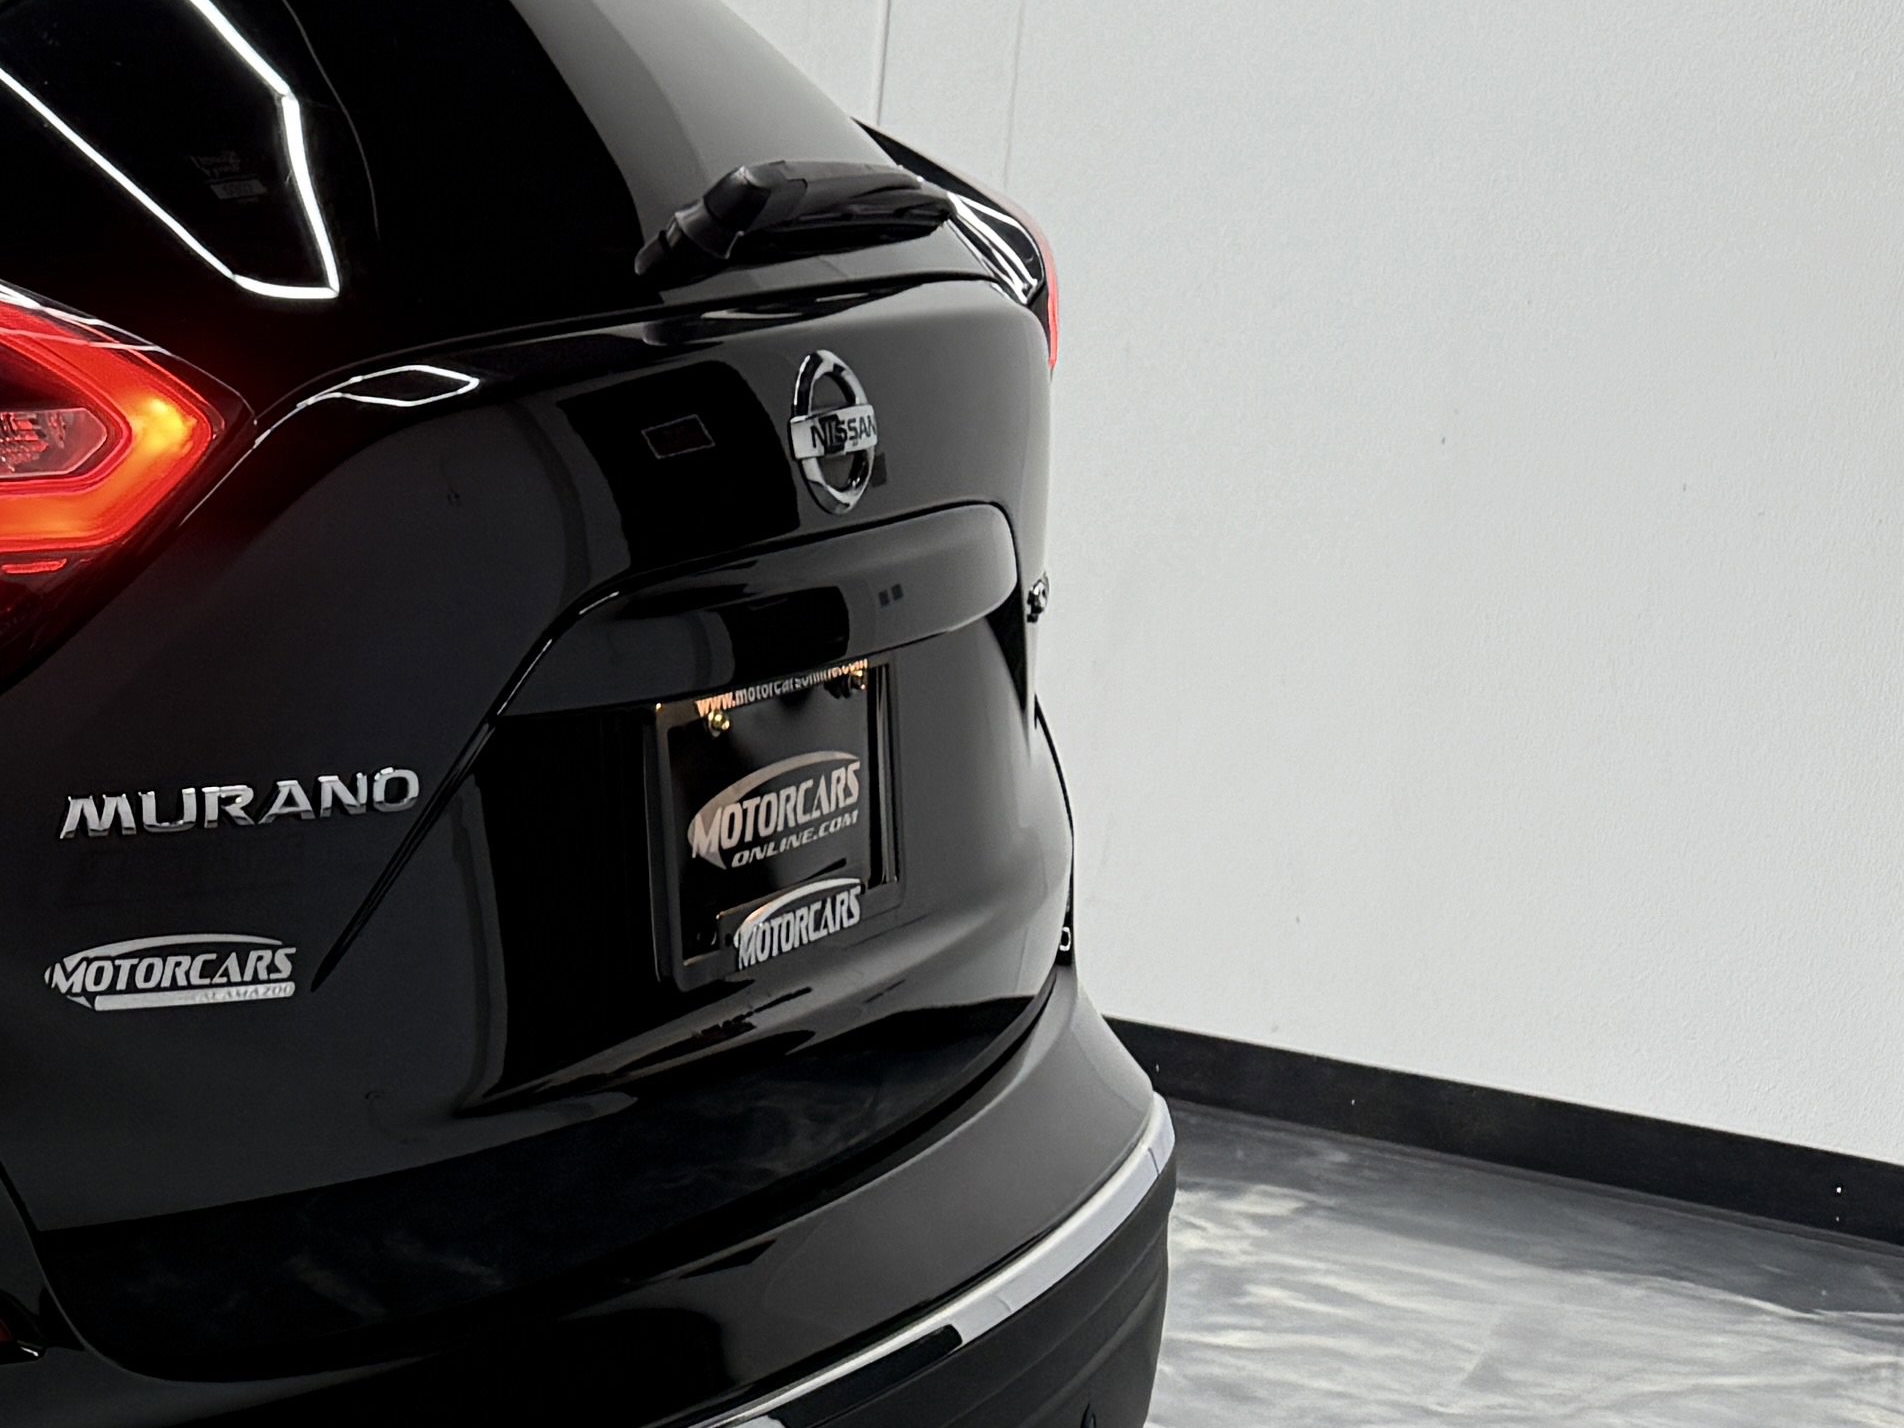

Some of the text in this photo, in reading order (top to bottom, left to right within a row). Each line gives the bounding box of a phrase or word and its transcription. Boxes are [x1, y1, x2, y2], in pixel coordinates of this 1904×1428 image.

[810, 414, 877, 449] NISSAN
[59, 766, 421, 840] MURANO
[691, 761, 861, 859] MOTORCARS
[730, 809, 859, 869] ONLINE.COM
[738, 884, 863, 970] MOTORCARS
[50, 947, 297, 994] MOTORCARS
[186, 982, 293, 1004] ALAMAZOO
